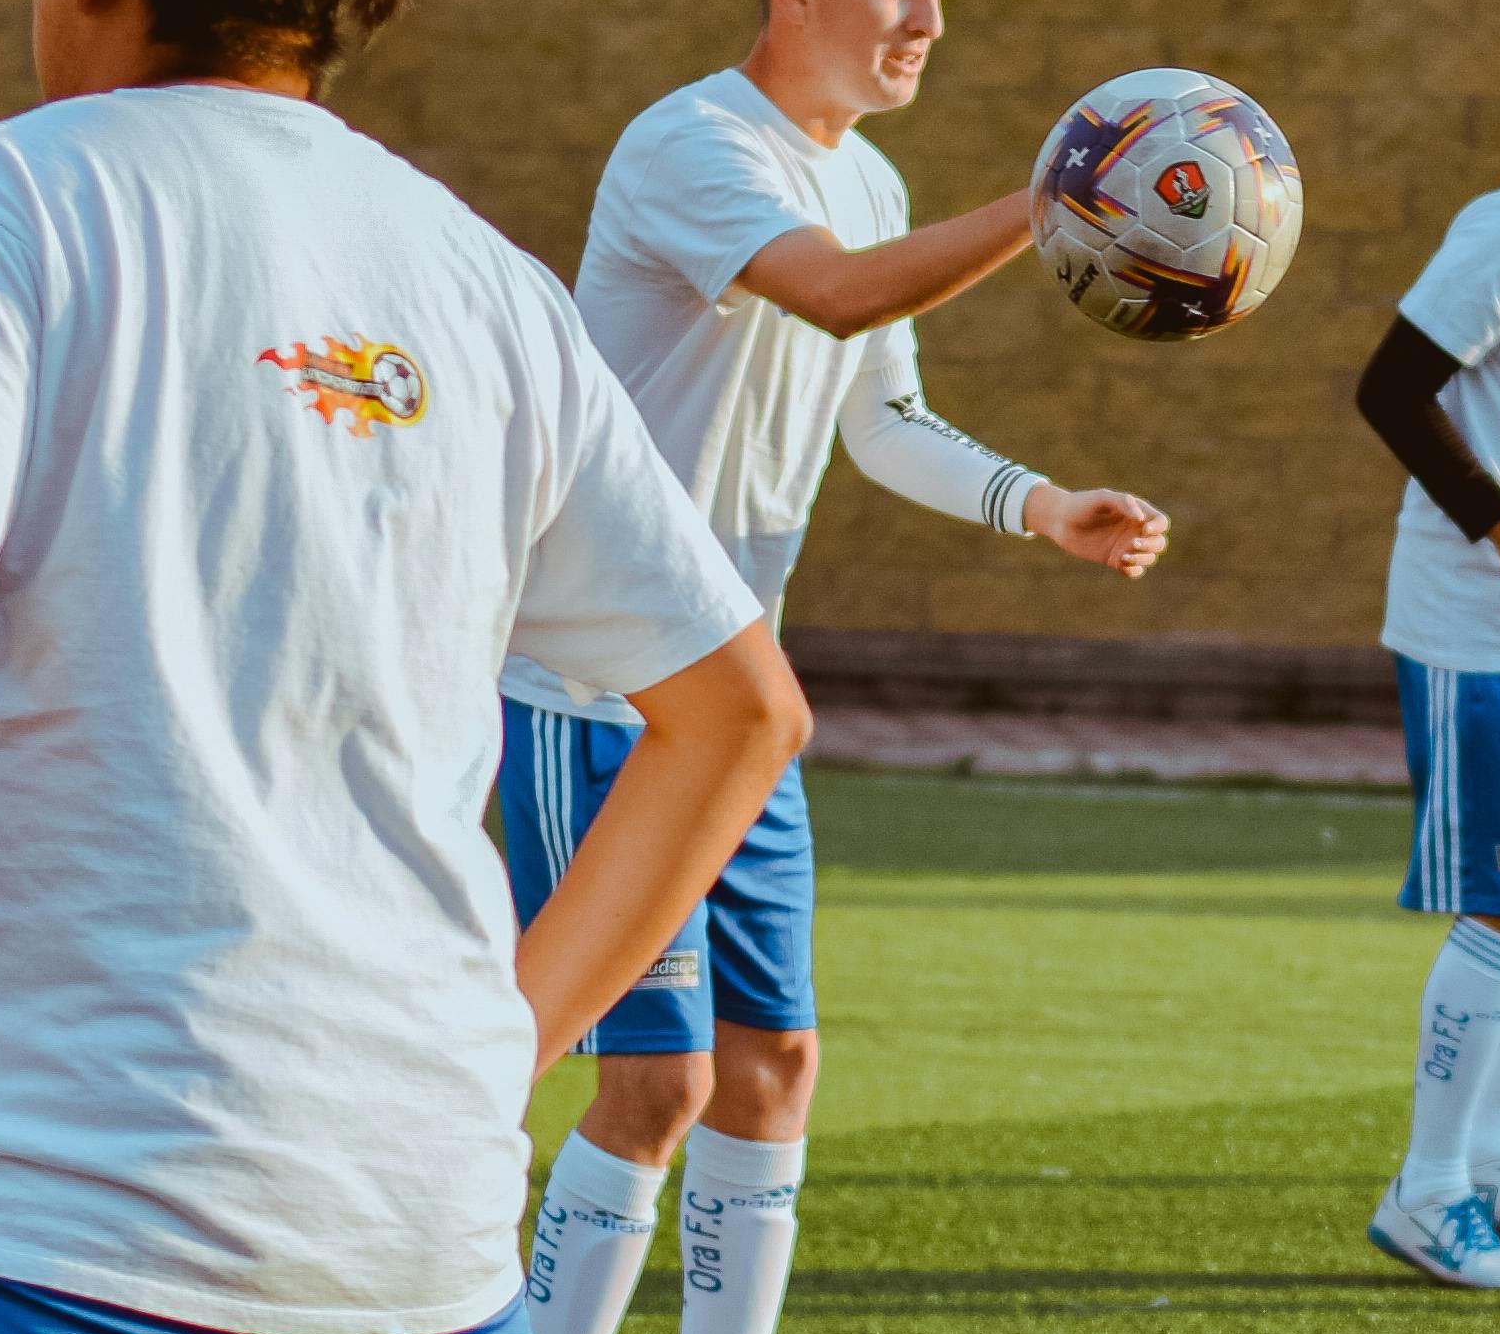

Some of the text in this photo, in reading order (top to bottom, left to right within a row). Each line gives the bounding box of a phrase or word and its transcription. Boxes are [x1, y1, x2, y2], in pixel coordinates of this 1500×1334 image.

[646, 957, 698, 975] udson
[1425, 1043, 1458, 1081] Ora
[527, 1252, 556, 1303] Ora
[687, 1245, 722, 1292] Ora
